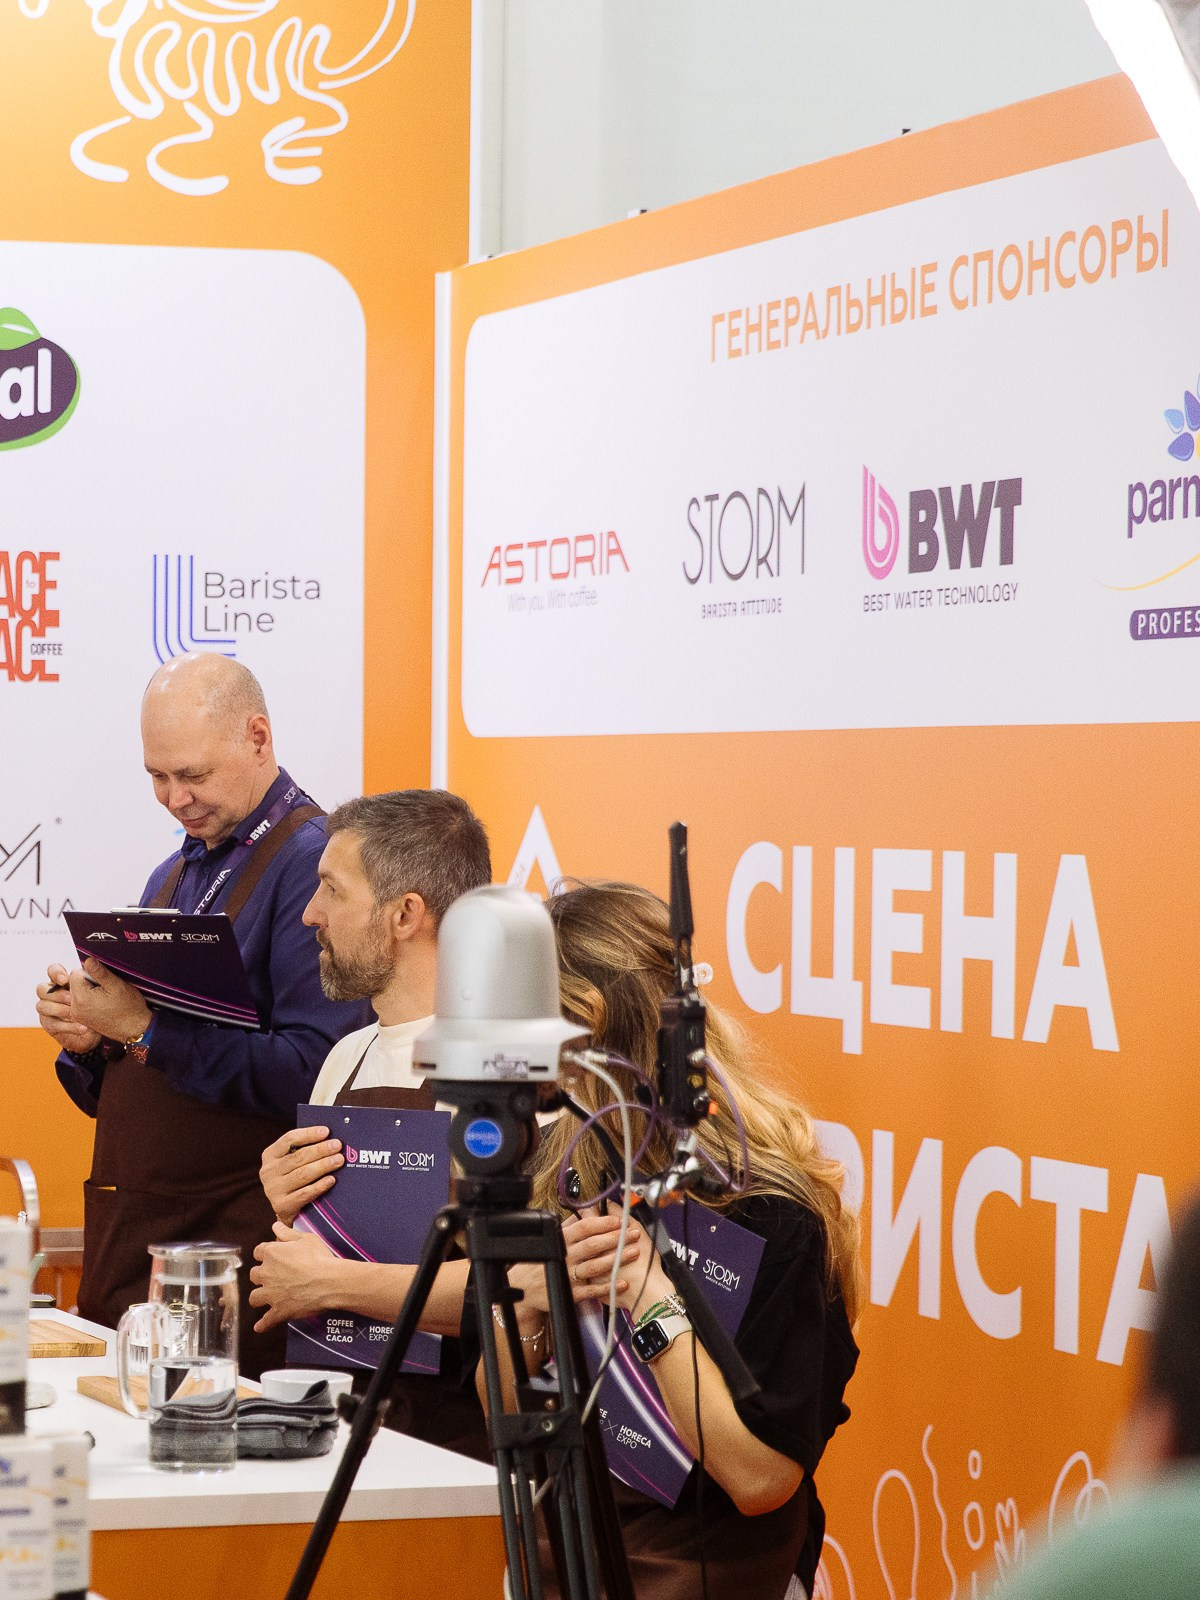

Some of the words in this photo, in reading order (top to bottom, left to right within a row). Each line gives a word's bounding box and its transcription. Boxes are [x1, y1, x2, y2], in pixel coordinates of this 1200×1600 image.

[710, 261, 938, 363] ГЕНЕРАЛЬНЫЕ
[949, 208, 1169, 311] СПОНСОРЫ
[1127, 475, 1200, 539] parm
[682, 481, 806, 585] STORM
[908, 477, 1023, 575] BWT
[481, 530, 630, 588] ASTORIA
[204, 571, 320, 600] Barista
[863, 593, 891, 613] BEST
[894, 589, 934, 610] WATER
[936, 582, 1019, 607] TECHNOLOGY
[507, 592, 526, 612] With
[547, 590, 566, 610] With
[701, 600, 738, 619] BARISTA
[740, 597, 782, 616] ATTITUDE
[204, 604, 274, 633] Line
[1137, 609, 1200, 636] PROFES
[30, 643, 63, 656] COFFEE
[249, 819, 272, 841] BWT
[193, 868, 231, 914] STORIA
[138, 932, 173, 940] BWT
[181, 933, 220, 942] STORM
[726, 841, 1120, 1055] СЦЕНА
[359, 1150, 391, 1165] BWT
[397, 1152, 434, 1167] STORM
[702, 1259, 740, 1290] STORM
[326, 1319, 354, 1328] COFFEE
[369, 1326, 394, 1334] HOREC
[326, 1335, 353, 1343] CACAO
[369, 1333, 388, 1342] EXPO
[616, 1433, 637, 1449] EXPO
[620, 1425, 652, 1449] HORECA
